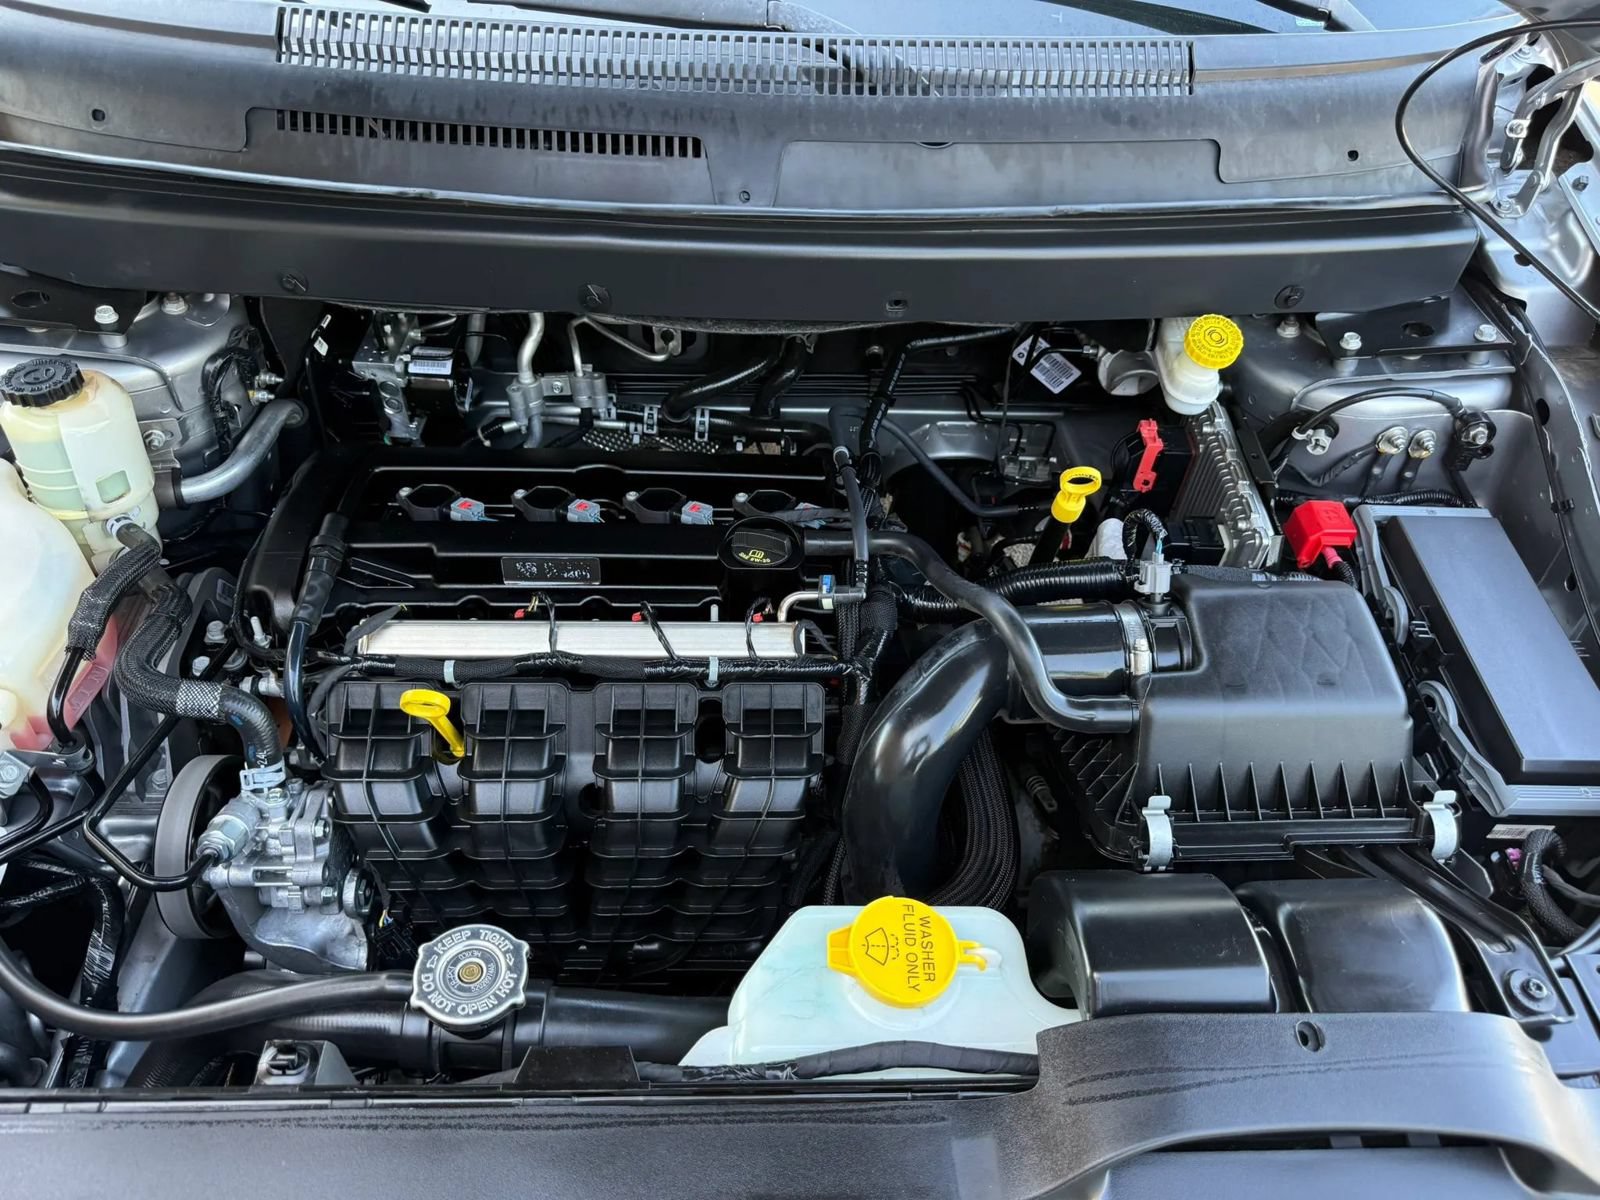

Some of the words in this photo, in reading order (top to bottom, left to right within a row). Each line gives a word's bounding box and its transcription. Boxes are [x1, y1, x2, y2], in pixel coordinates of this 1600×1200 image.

[434, 930, 471, 954] KEEP
[480, 929, 514, 952] TIGHT
[902, 904, 917, 947] FLUID
[919, 915, 936, 982] WASHER
[421, 973, 435, 992] DO
[428, 991, 456, 1013] NOT
[457, 995, 498, 1015] OPEN
[496, 970, 518, 998] HOT
[905, 953, 921, 992] ONLY
